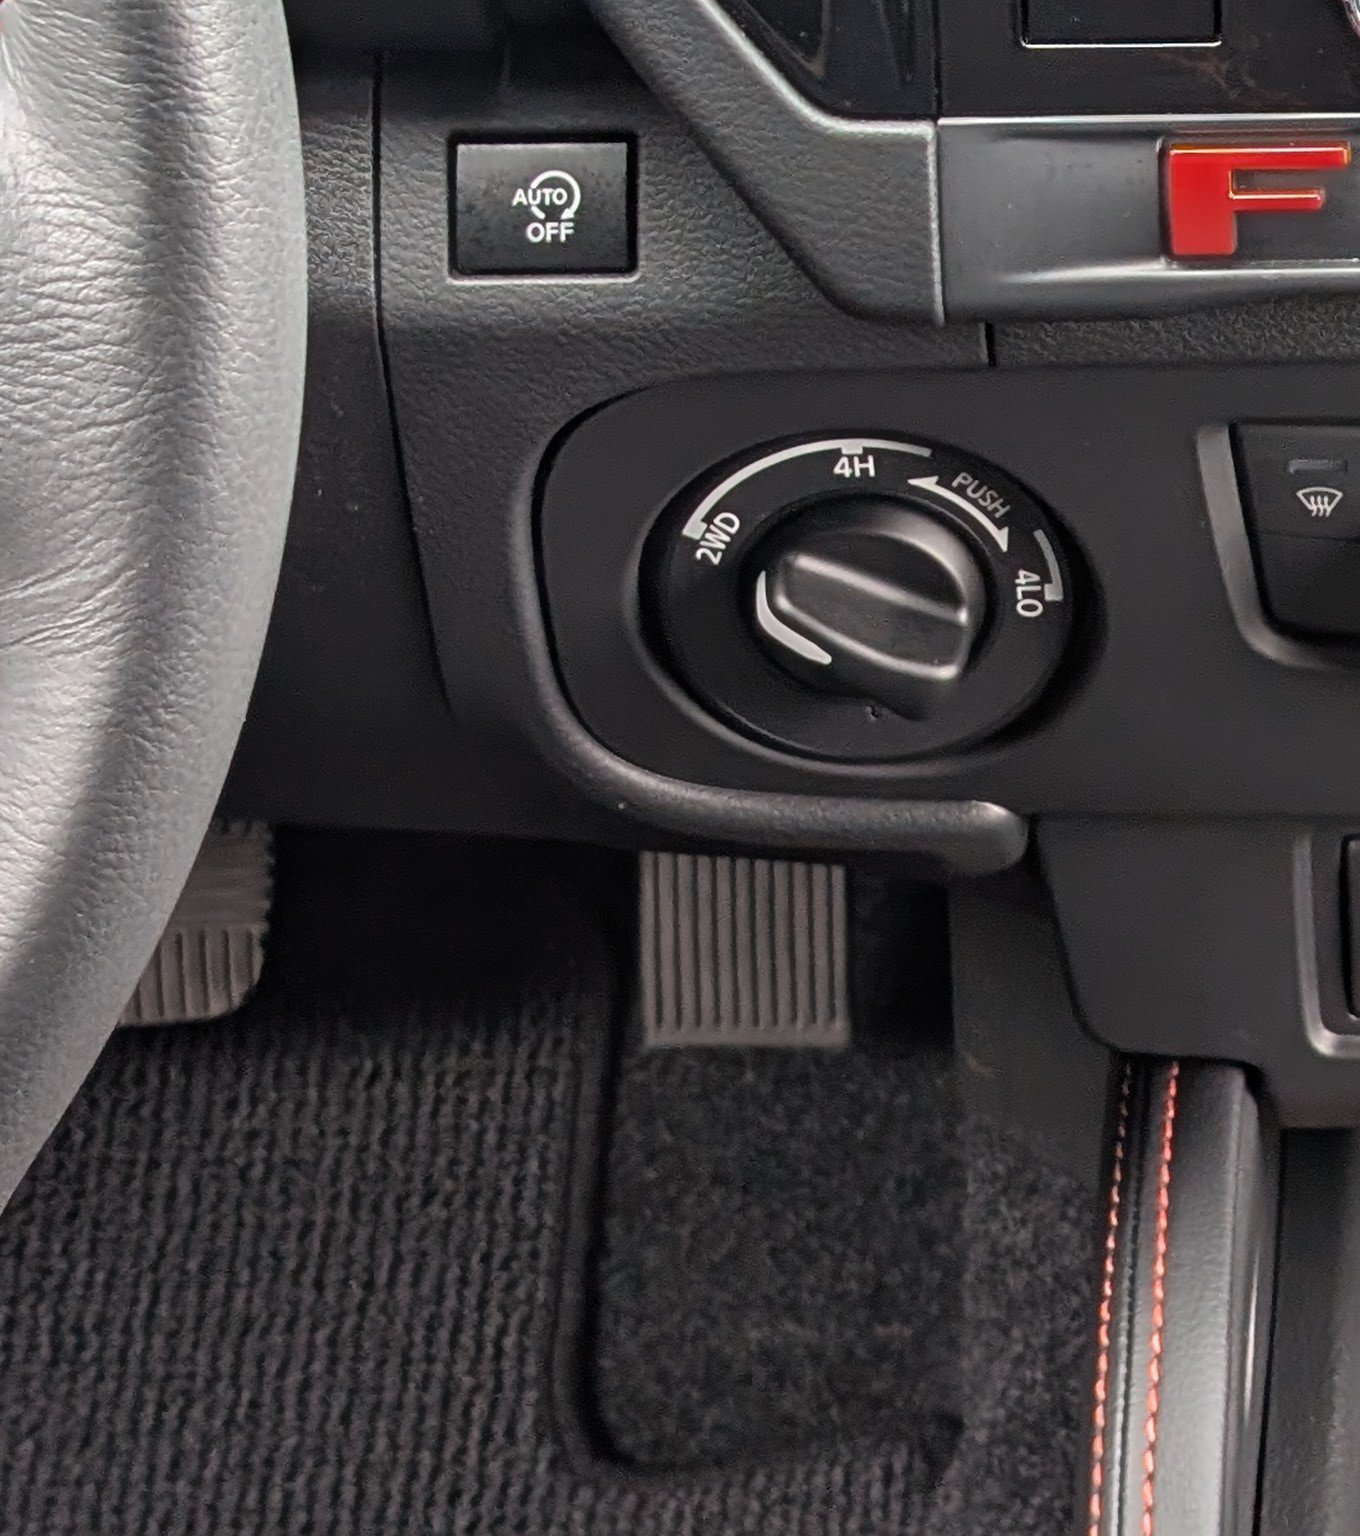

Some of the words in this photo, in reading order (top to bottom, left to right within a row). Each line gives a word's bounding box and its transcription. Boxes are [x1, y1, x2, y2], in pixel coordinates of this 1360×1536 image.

[512, 187, 568, 206] AUTO
[525, 221, 574, 244] OFF
[832, 455, 876, 479] 4H
[952, 471, 1012, 521] PUSH
[694, 510, 742, 566] 2WD
[1013, 568, 1045, 619] 4LO
